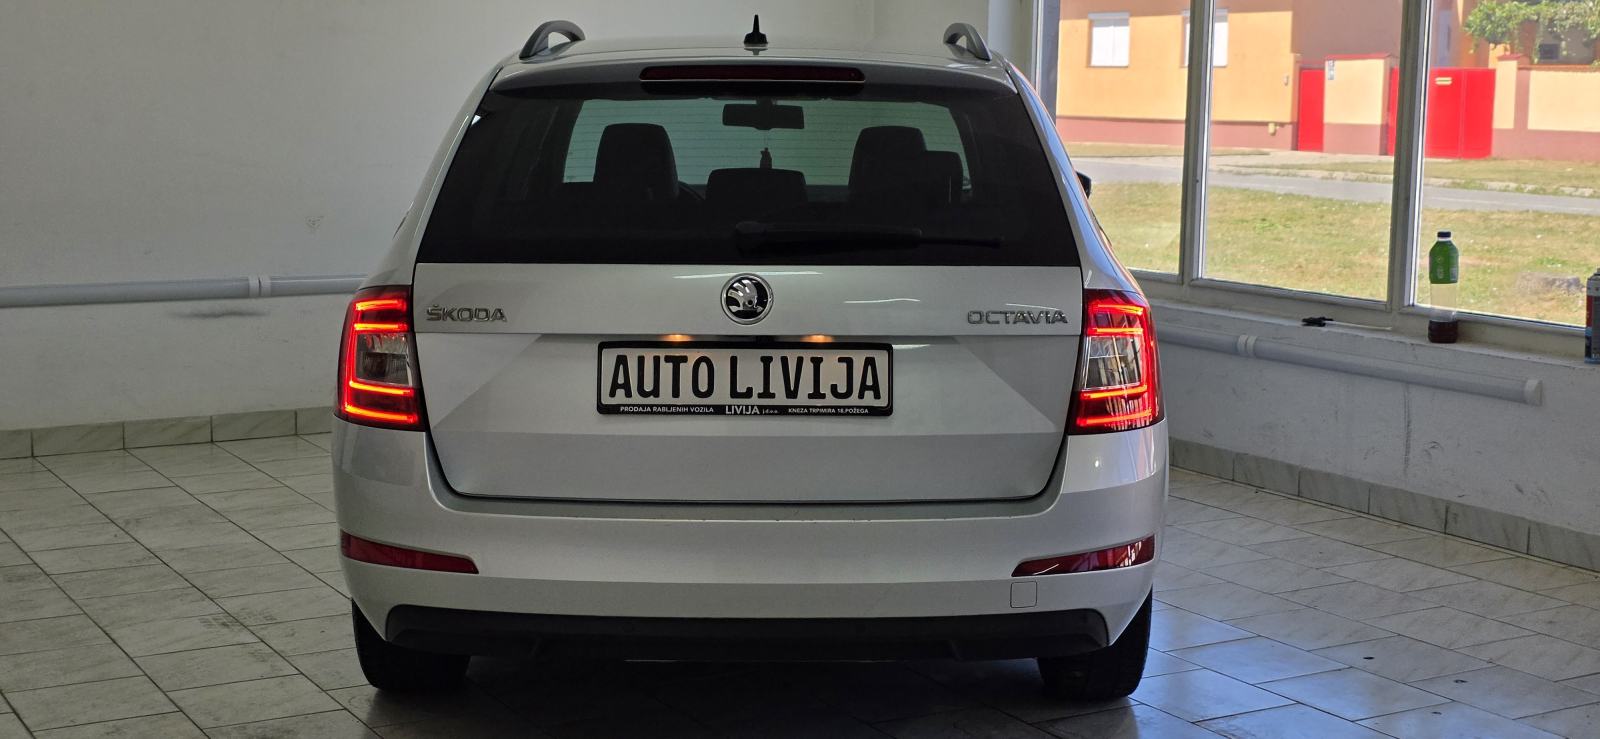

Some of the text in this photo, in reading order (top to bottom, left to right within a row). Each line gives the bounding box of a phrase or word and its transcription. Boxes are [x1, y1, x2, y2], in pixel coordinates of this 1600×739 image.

[426, 304, 507, 322] ŠKODA
[967, 310, 1068, 324] OCTAVIA
[609, 354, 882, 399] AUTO LIVIJA
[725, 405, 760, 415] LIVIJA
